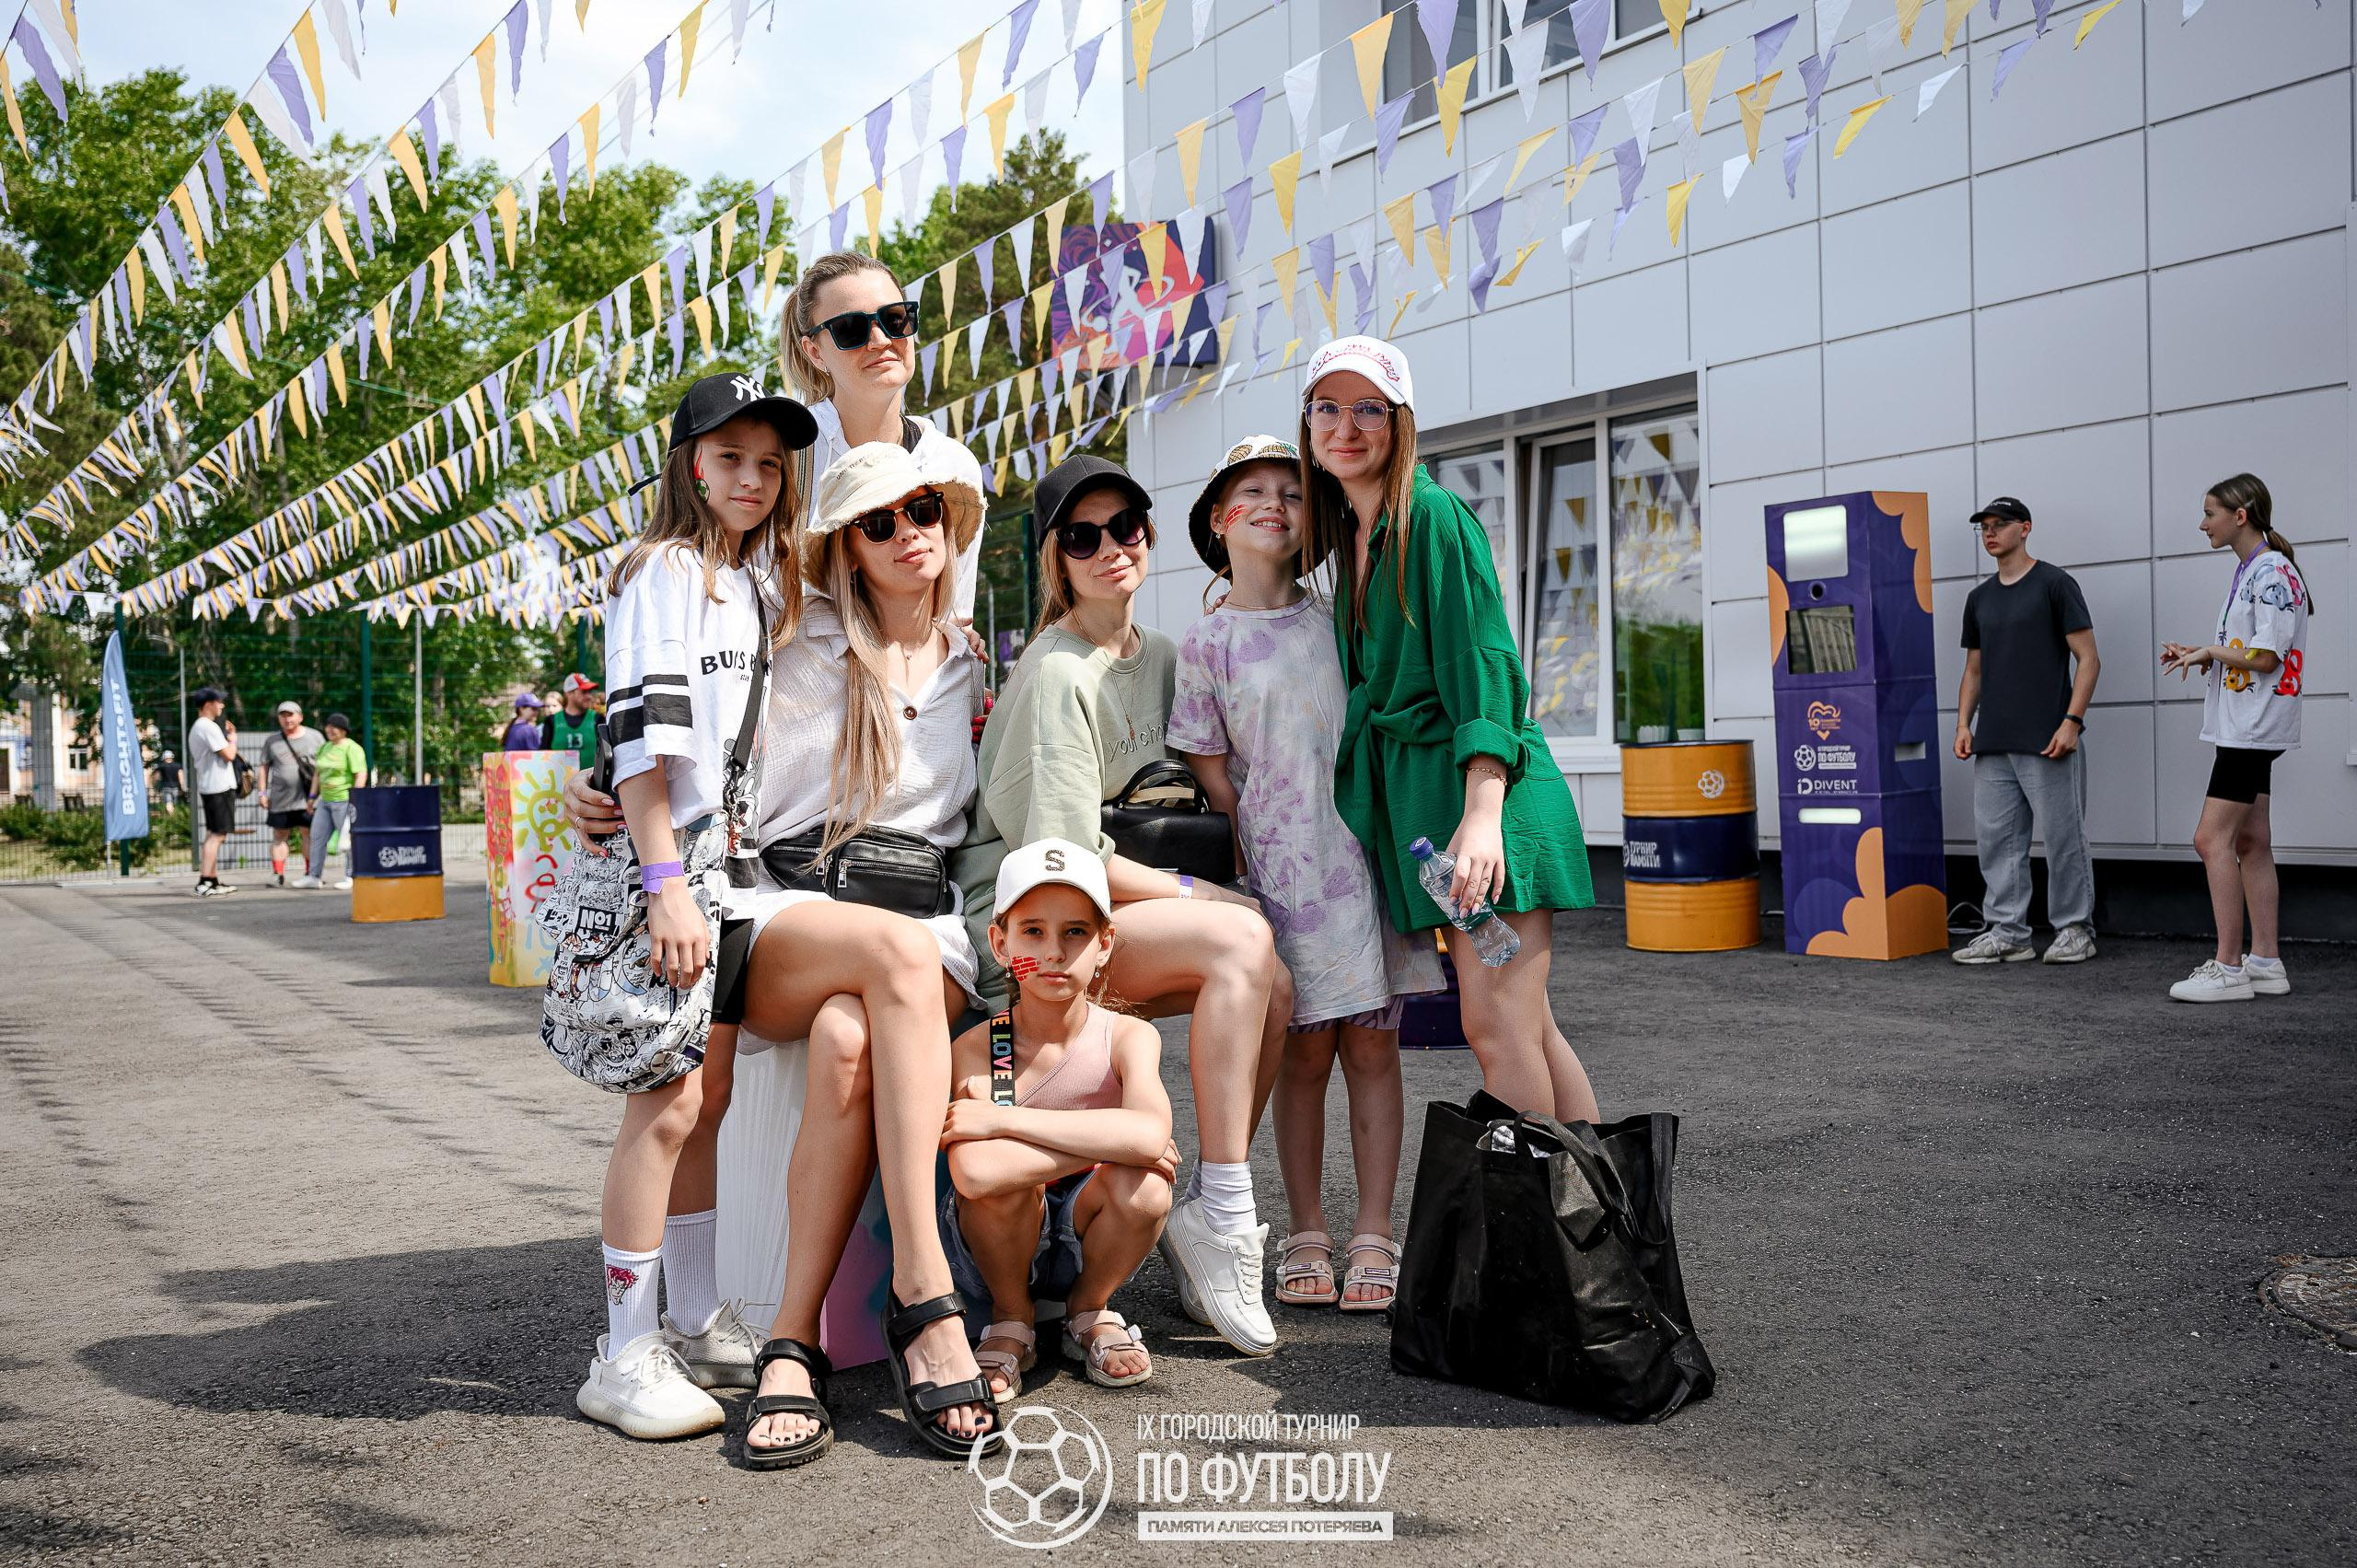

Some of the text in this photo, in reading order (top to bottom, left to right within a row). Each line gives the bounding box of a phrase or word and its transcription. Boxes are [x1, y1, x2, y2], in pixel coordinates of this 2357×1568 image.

[1140, 723, 1164, 747] cho
[1814, 780, 1858, 790] DIVENT
[1045, 849, 1065, 871] S
[993, 1034, 1013, 1080] LOVE
